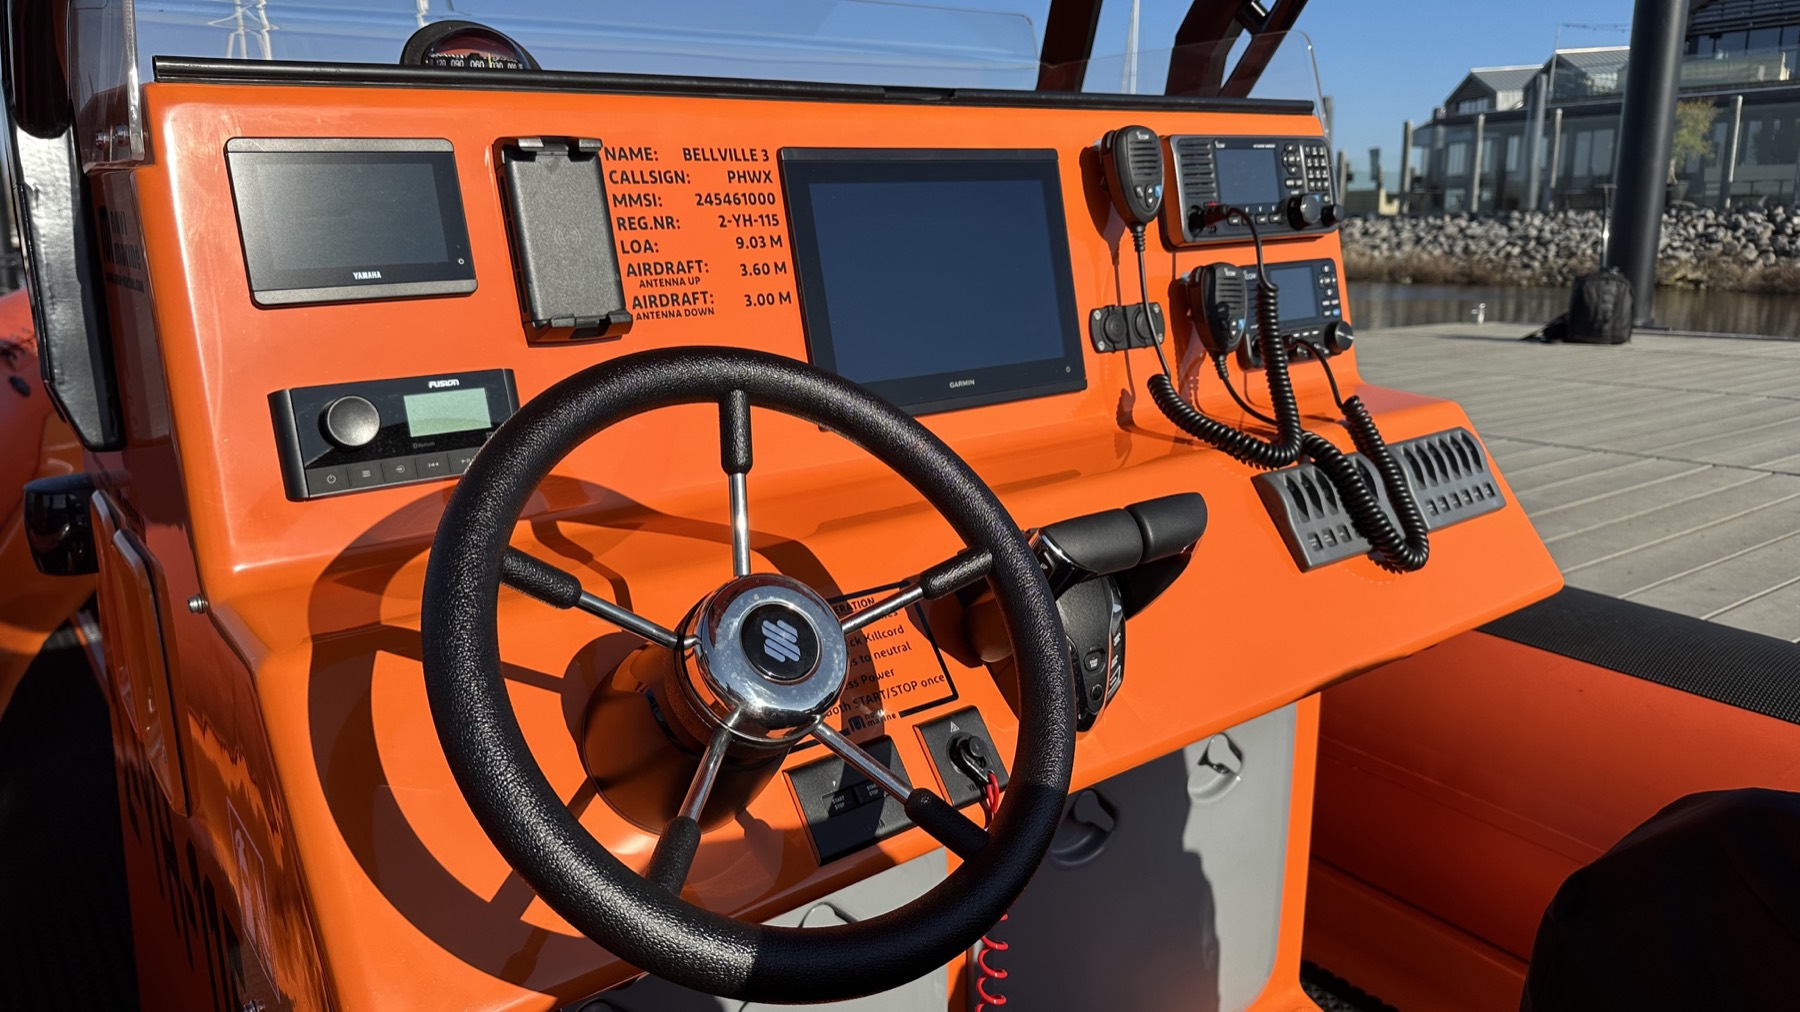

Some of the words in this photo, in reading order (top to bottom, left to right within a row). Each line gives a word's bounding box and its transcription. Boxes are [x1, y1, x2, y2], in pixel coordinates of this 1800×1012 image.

[604, 147, 659, 162] NAME:
[682, 148, 758, 162] BELLVILLE
[761, 149, 769, 162] 3
[608, 170, 691, 185] CALLSIGN:
[727, 170, 773, 184] PHWX
[612, 193, 663, 208] MMSI:
[695, 192, 776, 207] 245461000
[616, 216, 681, 231] REG.NR:
[718, 214, 779, 228] 2-YH-115
[620, 240, 659, 254] LOA:
[736, 236, 766, 250] 9.03
[769, 235, 783, 248] M
[626, 259, 710, 277] AIRDRAFT:
[740, 263, 770, 277] 3.60
[774, 261, 787, 275] M
[639, 277, 686, 289] ANTENNA
[688, 276, 700, 286] UP
[632, 291, 715, 310] AIRDRAFT:
[744, 293, 775, 307] 3.00
[778, 291, 792, 305] M
[636, 309, 682, 321] ANTENNA
[684, 307, 715, 318] DOWN
[949, 379, 975, 389] GARMIN
[833, 597, 875, 613] ERATION
[864, 625, 905, 643] Killcord
[873, 641, 912, 660] neutral
[860, 669, 895, 684] Power
[853, 680, 918, 708] START/STOP
[920, 674, 945, 688] once
